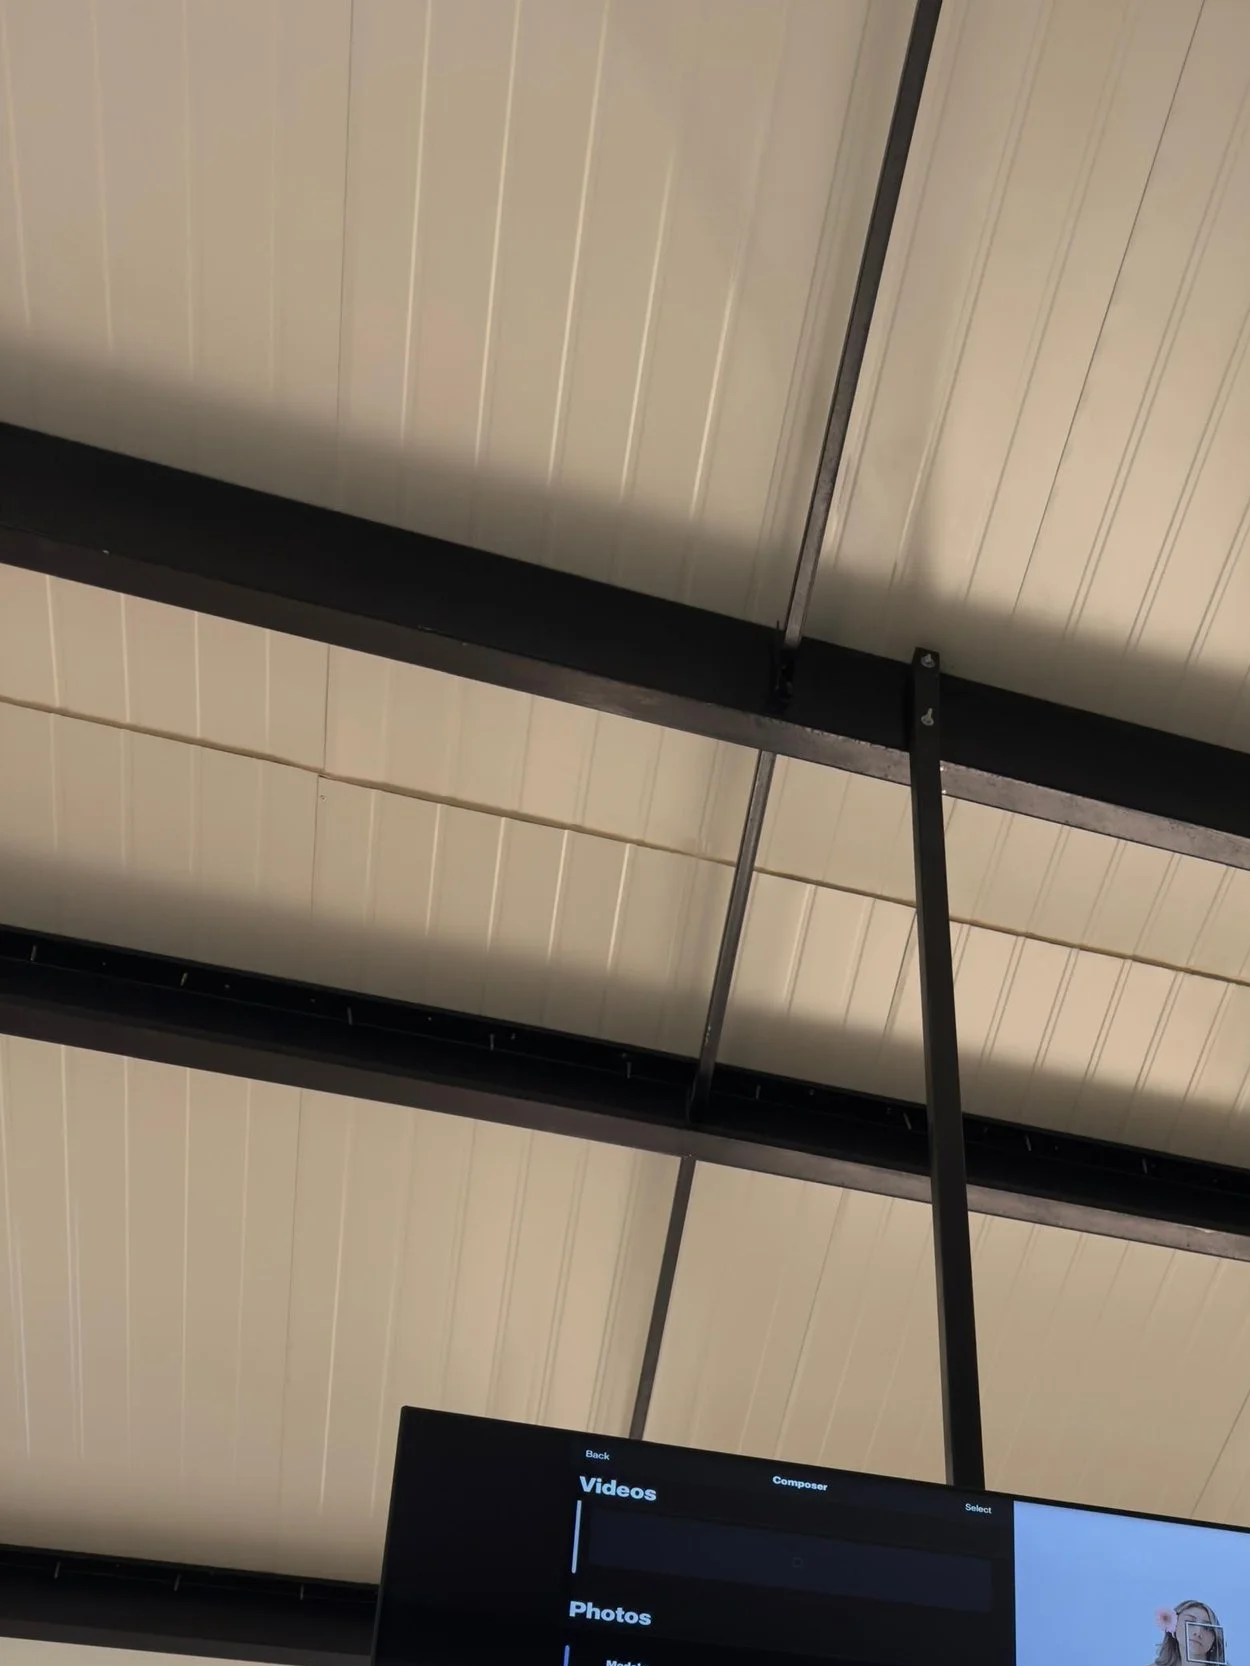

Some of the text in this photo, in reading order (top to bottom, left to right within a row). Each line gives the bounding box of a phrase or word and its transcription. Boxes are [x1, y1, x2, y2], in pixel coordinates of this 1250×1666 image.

[585, 1449, 610, 1461] Back
[579, 1475, 657, 1501] Videos
[772, 1475, 828, 1491] Composer
[965, 1503, 992, 1514] Select
[569, 1600, 652, 1626] Photos
